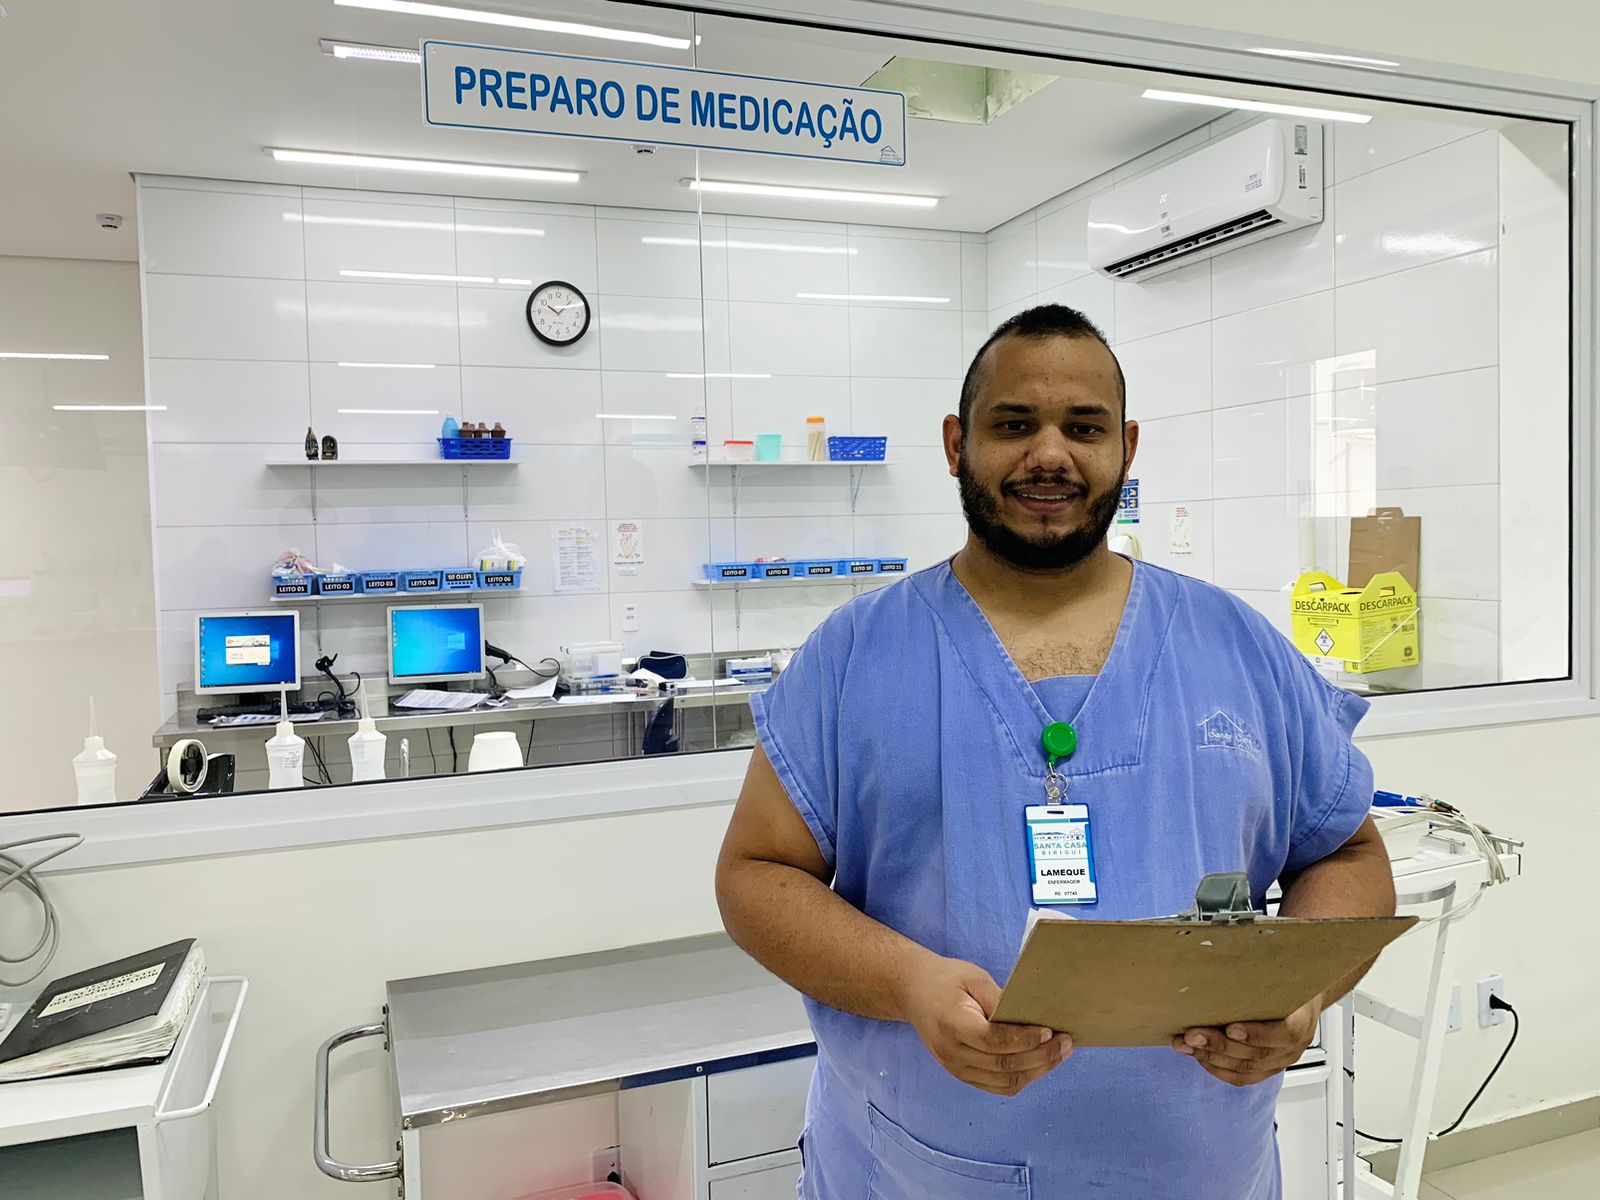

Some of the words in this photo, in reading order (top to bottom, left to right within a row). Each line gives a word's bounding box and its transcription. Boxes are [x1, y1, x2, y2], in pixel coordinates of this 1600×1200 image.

[455, 66, 625, 118] PREPARO
[636, 84, 681, 123] DE
[690, 90, 882, 148] MEDICAÇÃO
[1295, 600, 1350, 613] DESCARPACK
[1360, 595, 1413, 611] DESCARPACK
